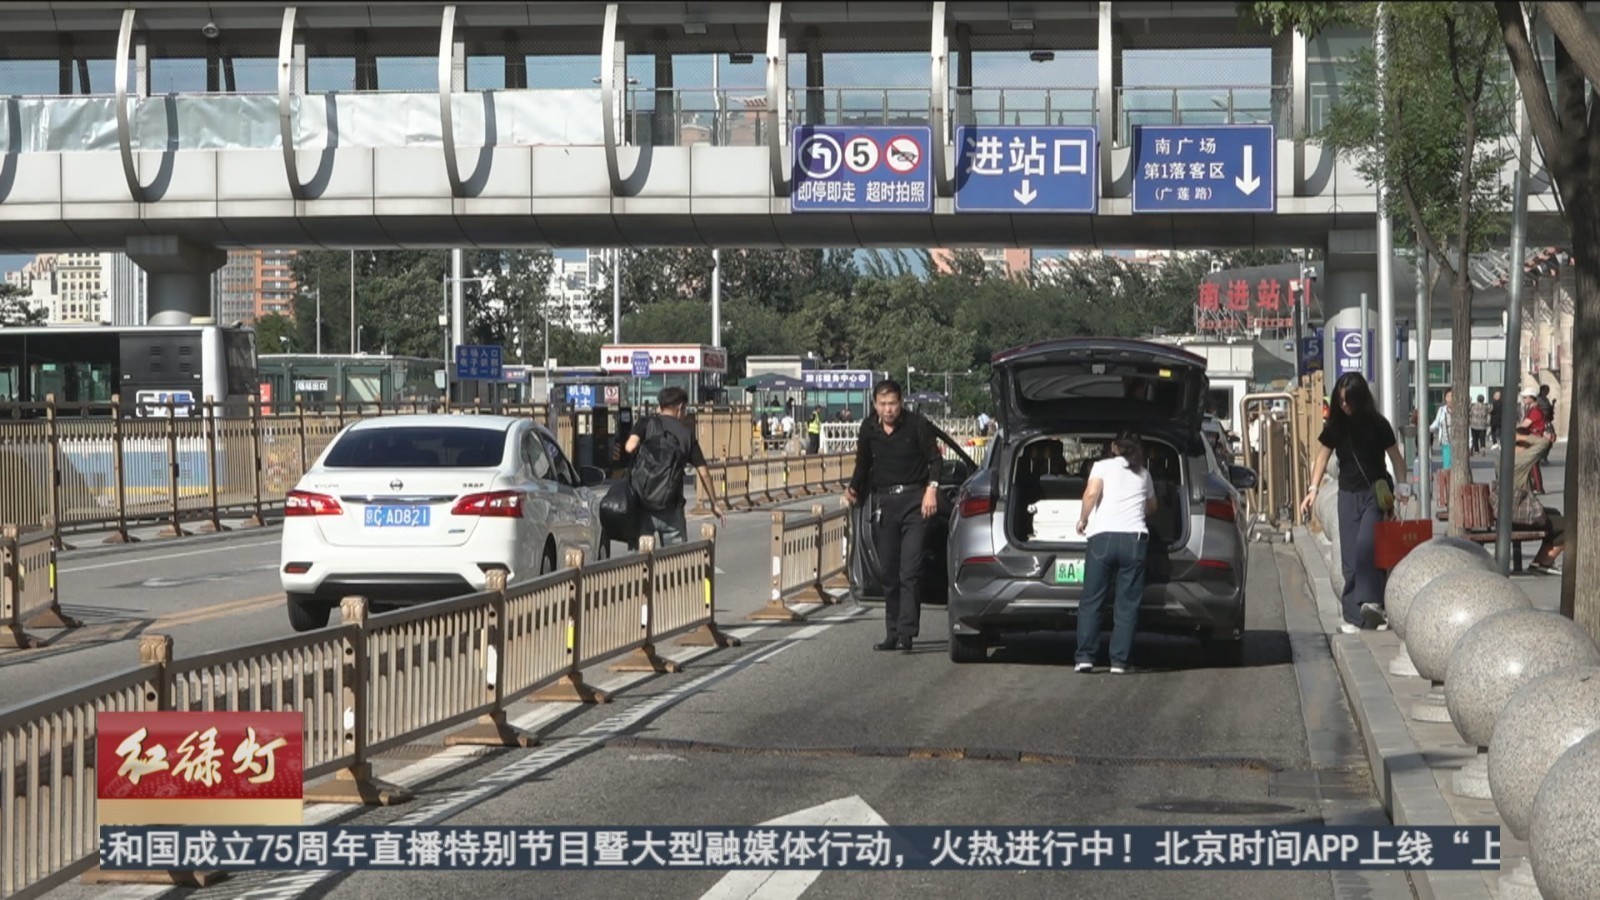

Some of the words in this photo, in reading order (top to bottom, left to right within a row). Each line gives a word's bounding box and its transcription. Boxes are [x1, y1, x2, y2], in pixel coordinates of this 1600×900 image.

[853, 142, 870, 167] 5
[965, 136, 1088, 176] 进站口
[1155, 137, 1217, 156] 南广场
[1143, 161, 1226, 181] 第1落客区
[797, 181, 856, 203] 即停即走
[865, 181, 925, 203] 超时拍照
[1198, 278, 1311, 311] 南进站口
[1246, 315, 1294, 329] Entran
[1308, 339, 1320, 356] 5
